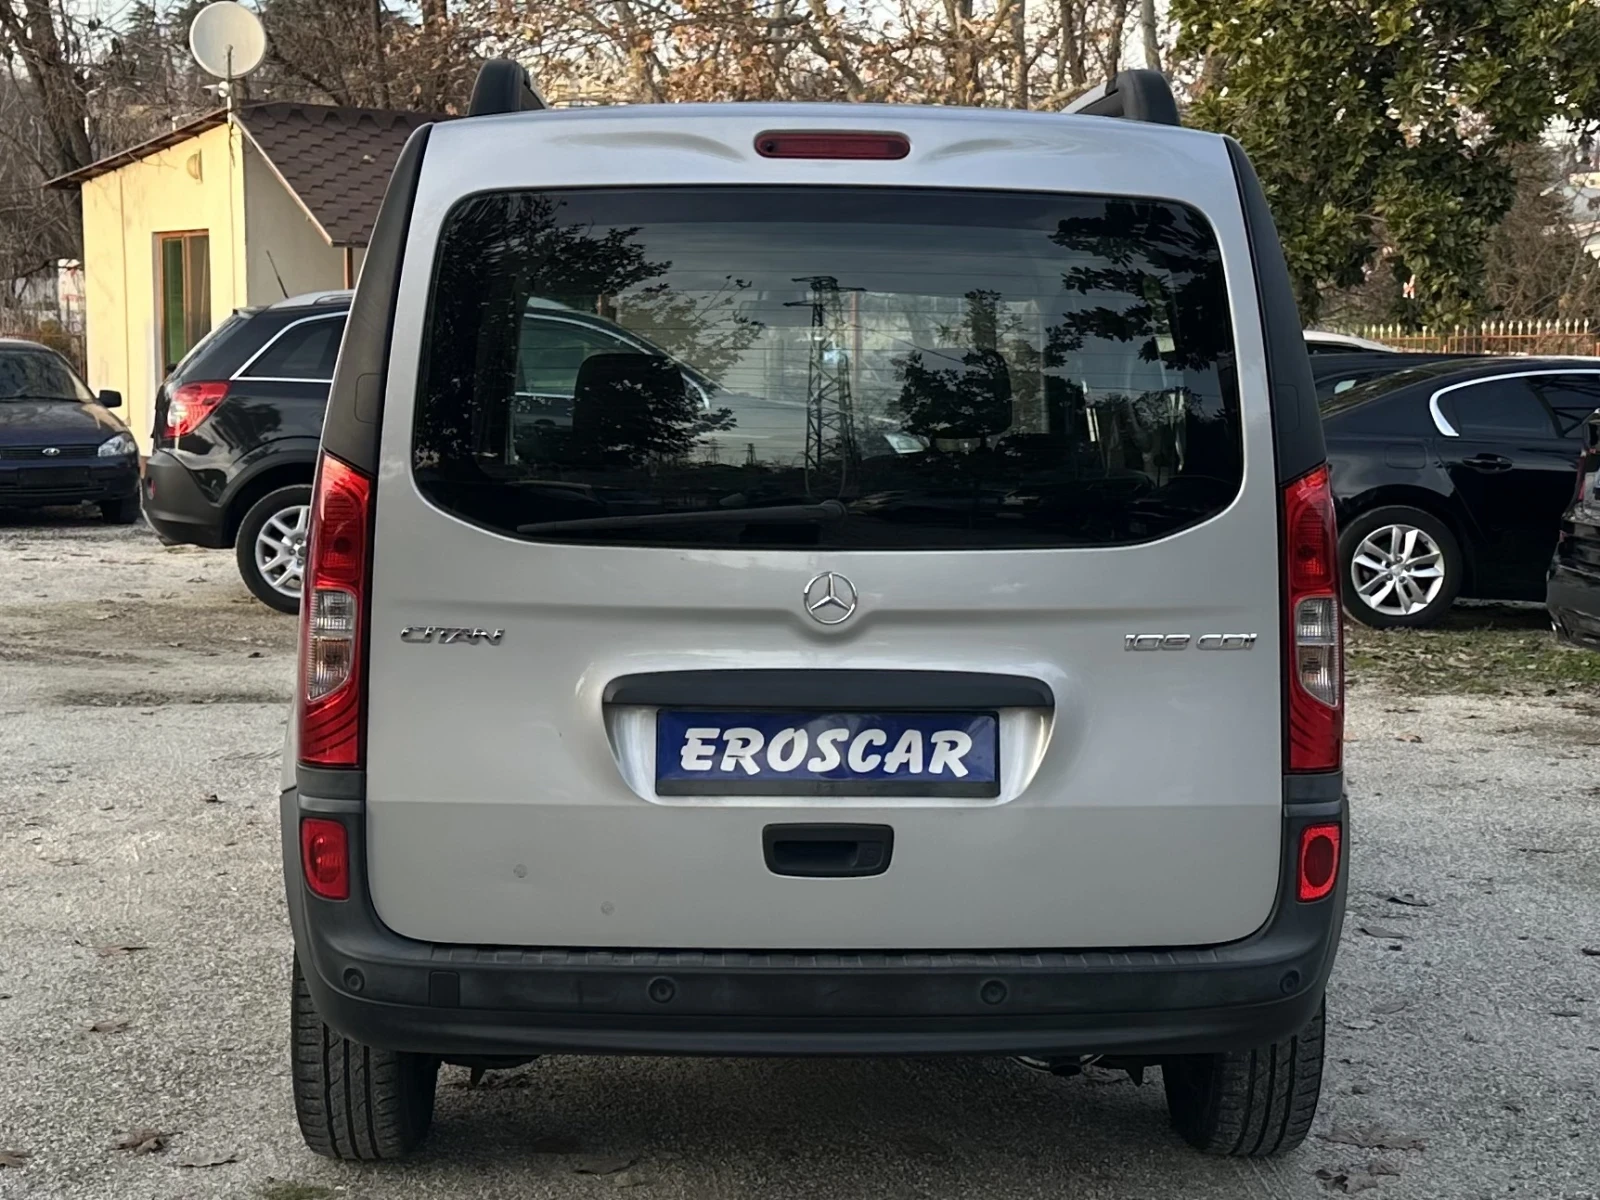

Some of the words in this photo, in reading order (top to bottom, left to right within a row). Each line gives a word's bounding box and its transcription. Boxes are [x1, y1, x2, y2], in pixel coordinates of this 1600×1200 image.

[400, 626, 505, 646] CITAN
[1196, 633, 1257, 651] CDI
[680, 727, 972, 777] EROSCAR
